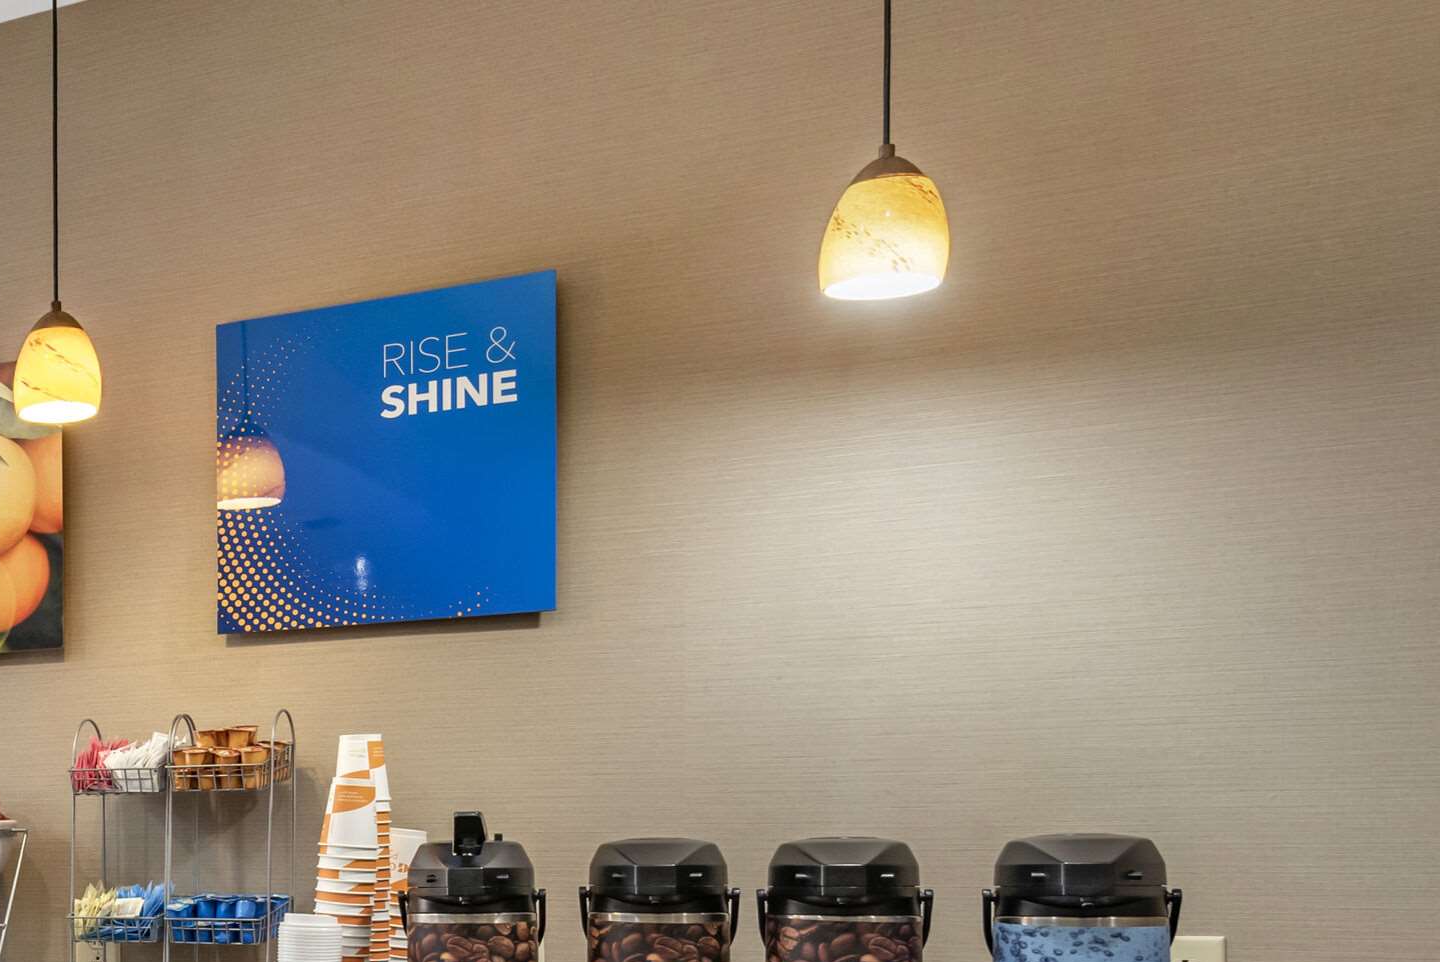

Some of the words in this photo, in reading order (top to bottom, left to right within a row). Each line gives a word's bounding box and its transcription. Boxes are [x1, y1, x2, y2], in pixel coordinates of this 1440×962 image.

[383, 332, 469, 378] RISE
[486, 326, 516, 364] &
[380, 369, 518, 419] SHINE
